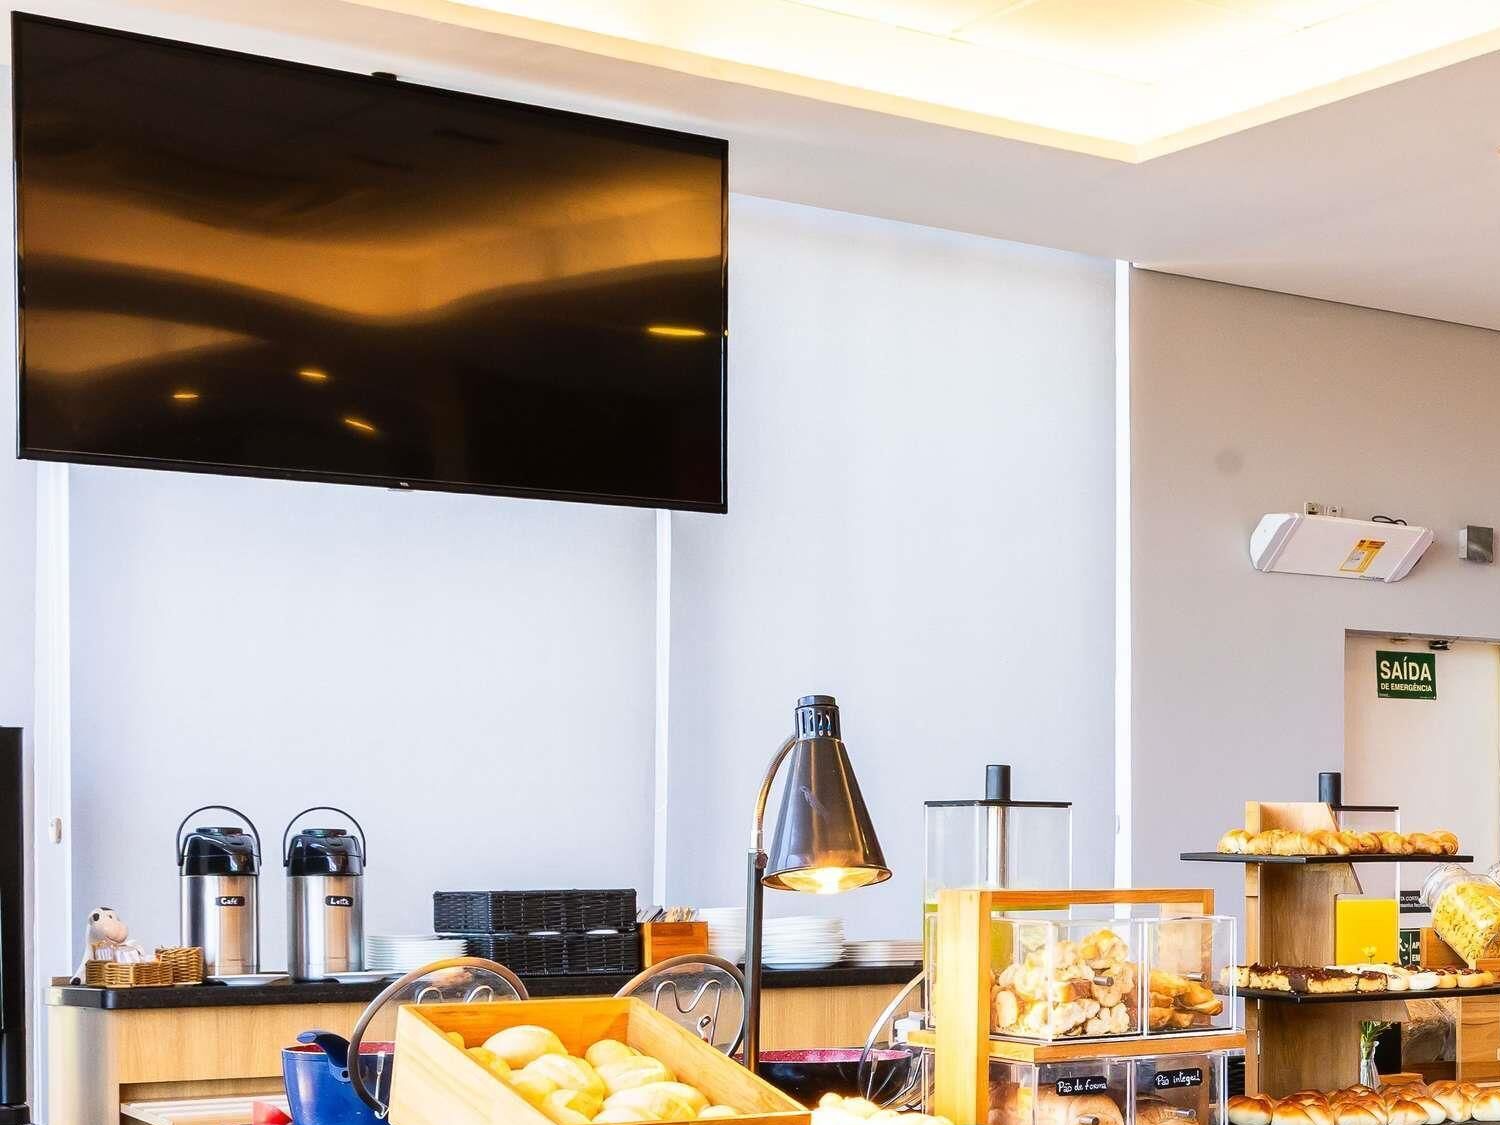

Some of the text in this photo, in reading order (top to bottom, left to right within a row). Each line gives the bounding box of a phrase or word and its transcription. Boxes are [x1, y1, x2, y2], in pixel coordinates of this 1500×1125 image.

[1380, 656, 1431, 681] SAÍDA
[1391, 683, 1432, 692] EMERGÊNCIA
[1057, 1081, 1072, 1093] Pão
[1074, 1079, 1083, 1091] de
